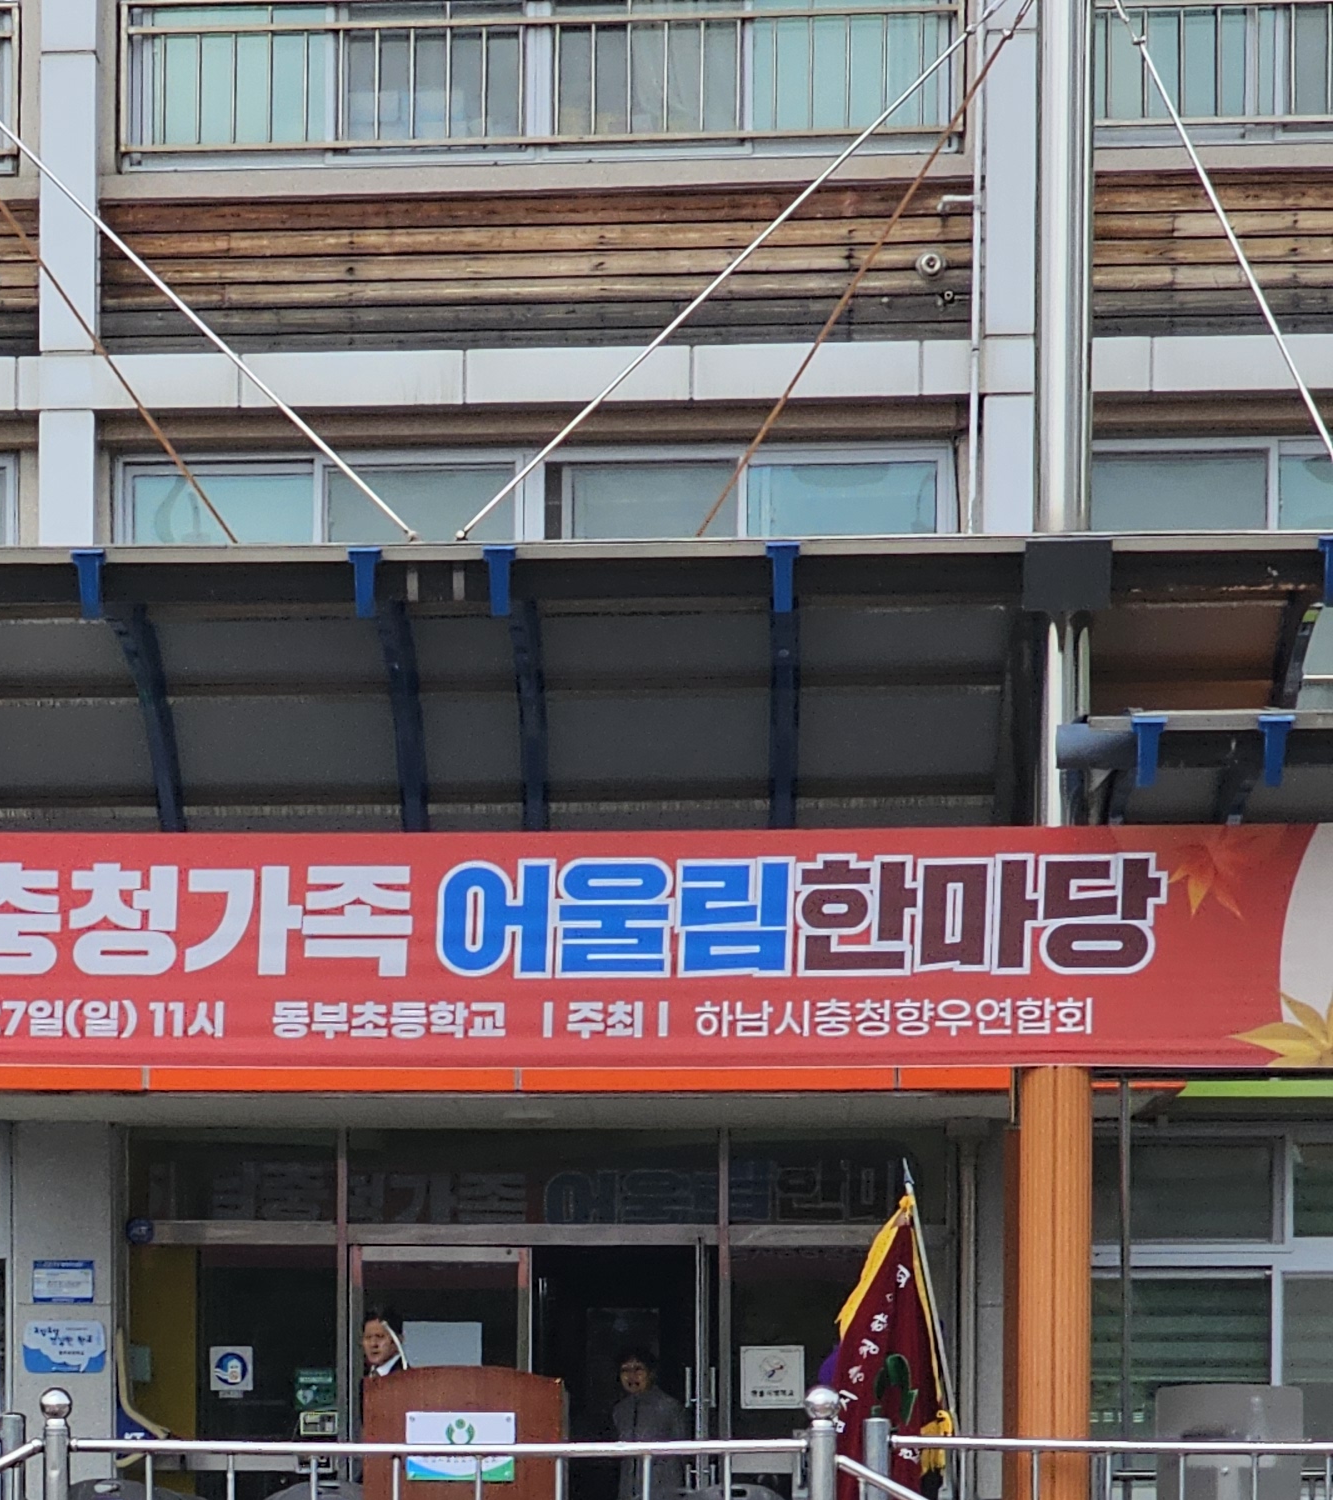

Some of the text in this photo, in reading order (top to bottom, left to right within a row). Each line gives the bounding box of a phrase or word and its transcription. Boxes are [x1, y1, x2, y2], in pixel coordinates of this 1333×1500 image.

[434, 851, 1171, 980] 어울림한마당
[148, 999, 226, 1038] 11시
[271, 999, 507, 1040] 동부초등학교
[694, 996, 1094, 1039] 하남시충청향우연합회
